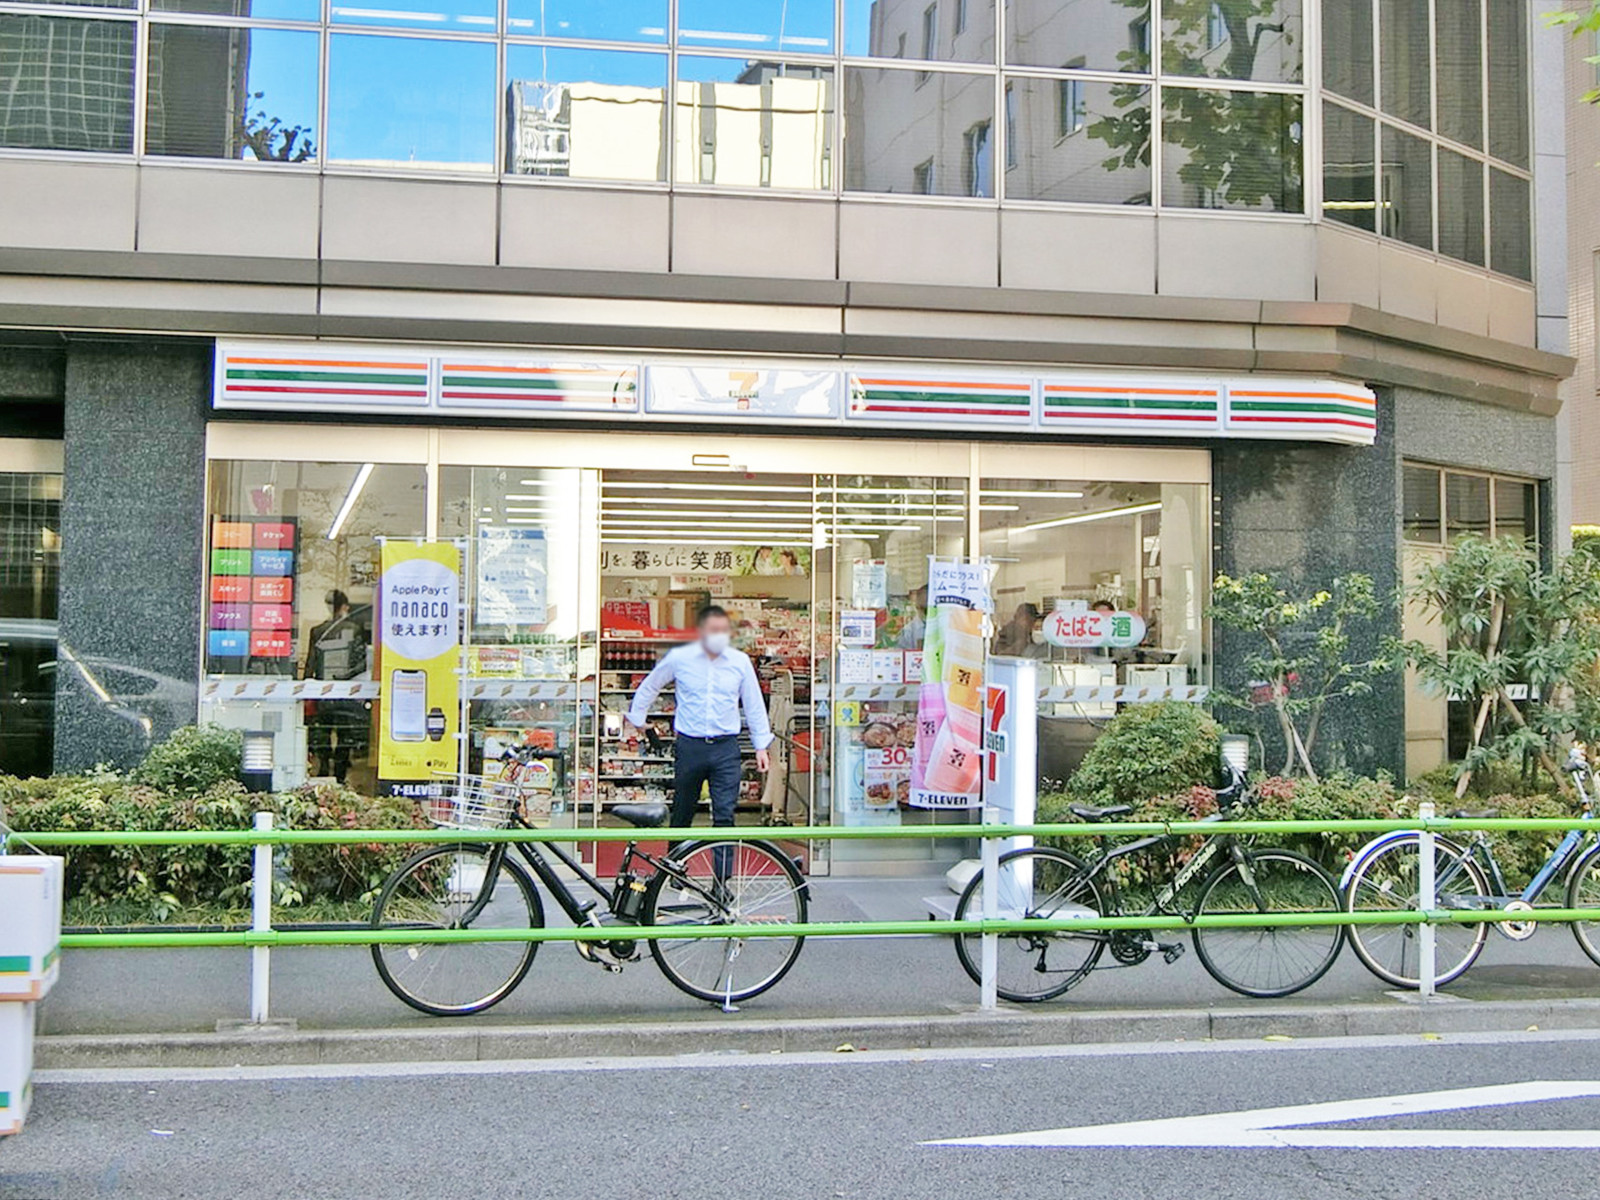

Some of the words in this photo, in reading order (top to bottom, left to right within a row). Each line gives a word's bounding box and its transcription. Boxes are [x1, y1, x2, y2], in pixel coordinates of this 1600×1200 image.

[262, 530, 285, 539] チケット
[219, 558, 242, 566] プリント
[218, 584, 243, 593] スキャン
[391, 585, 420, 595] Apple
[391, 601, 449, 619] nanaco
[391, 623, 448, 637] 使えます!
[1056, 615, 1103, 637] たばこ
[1111, 616, 1132, 638] 酒
